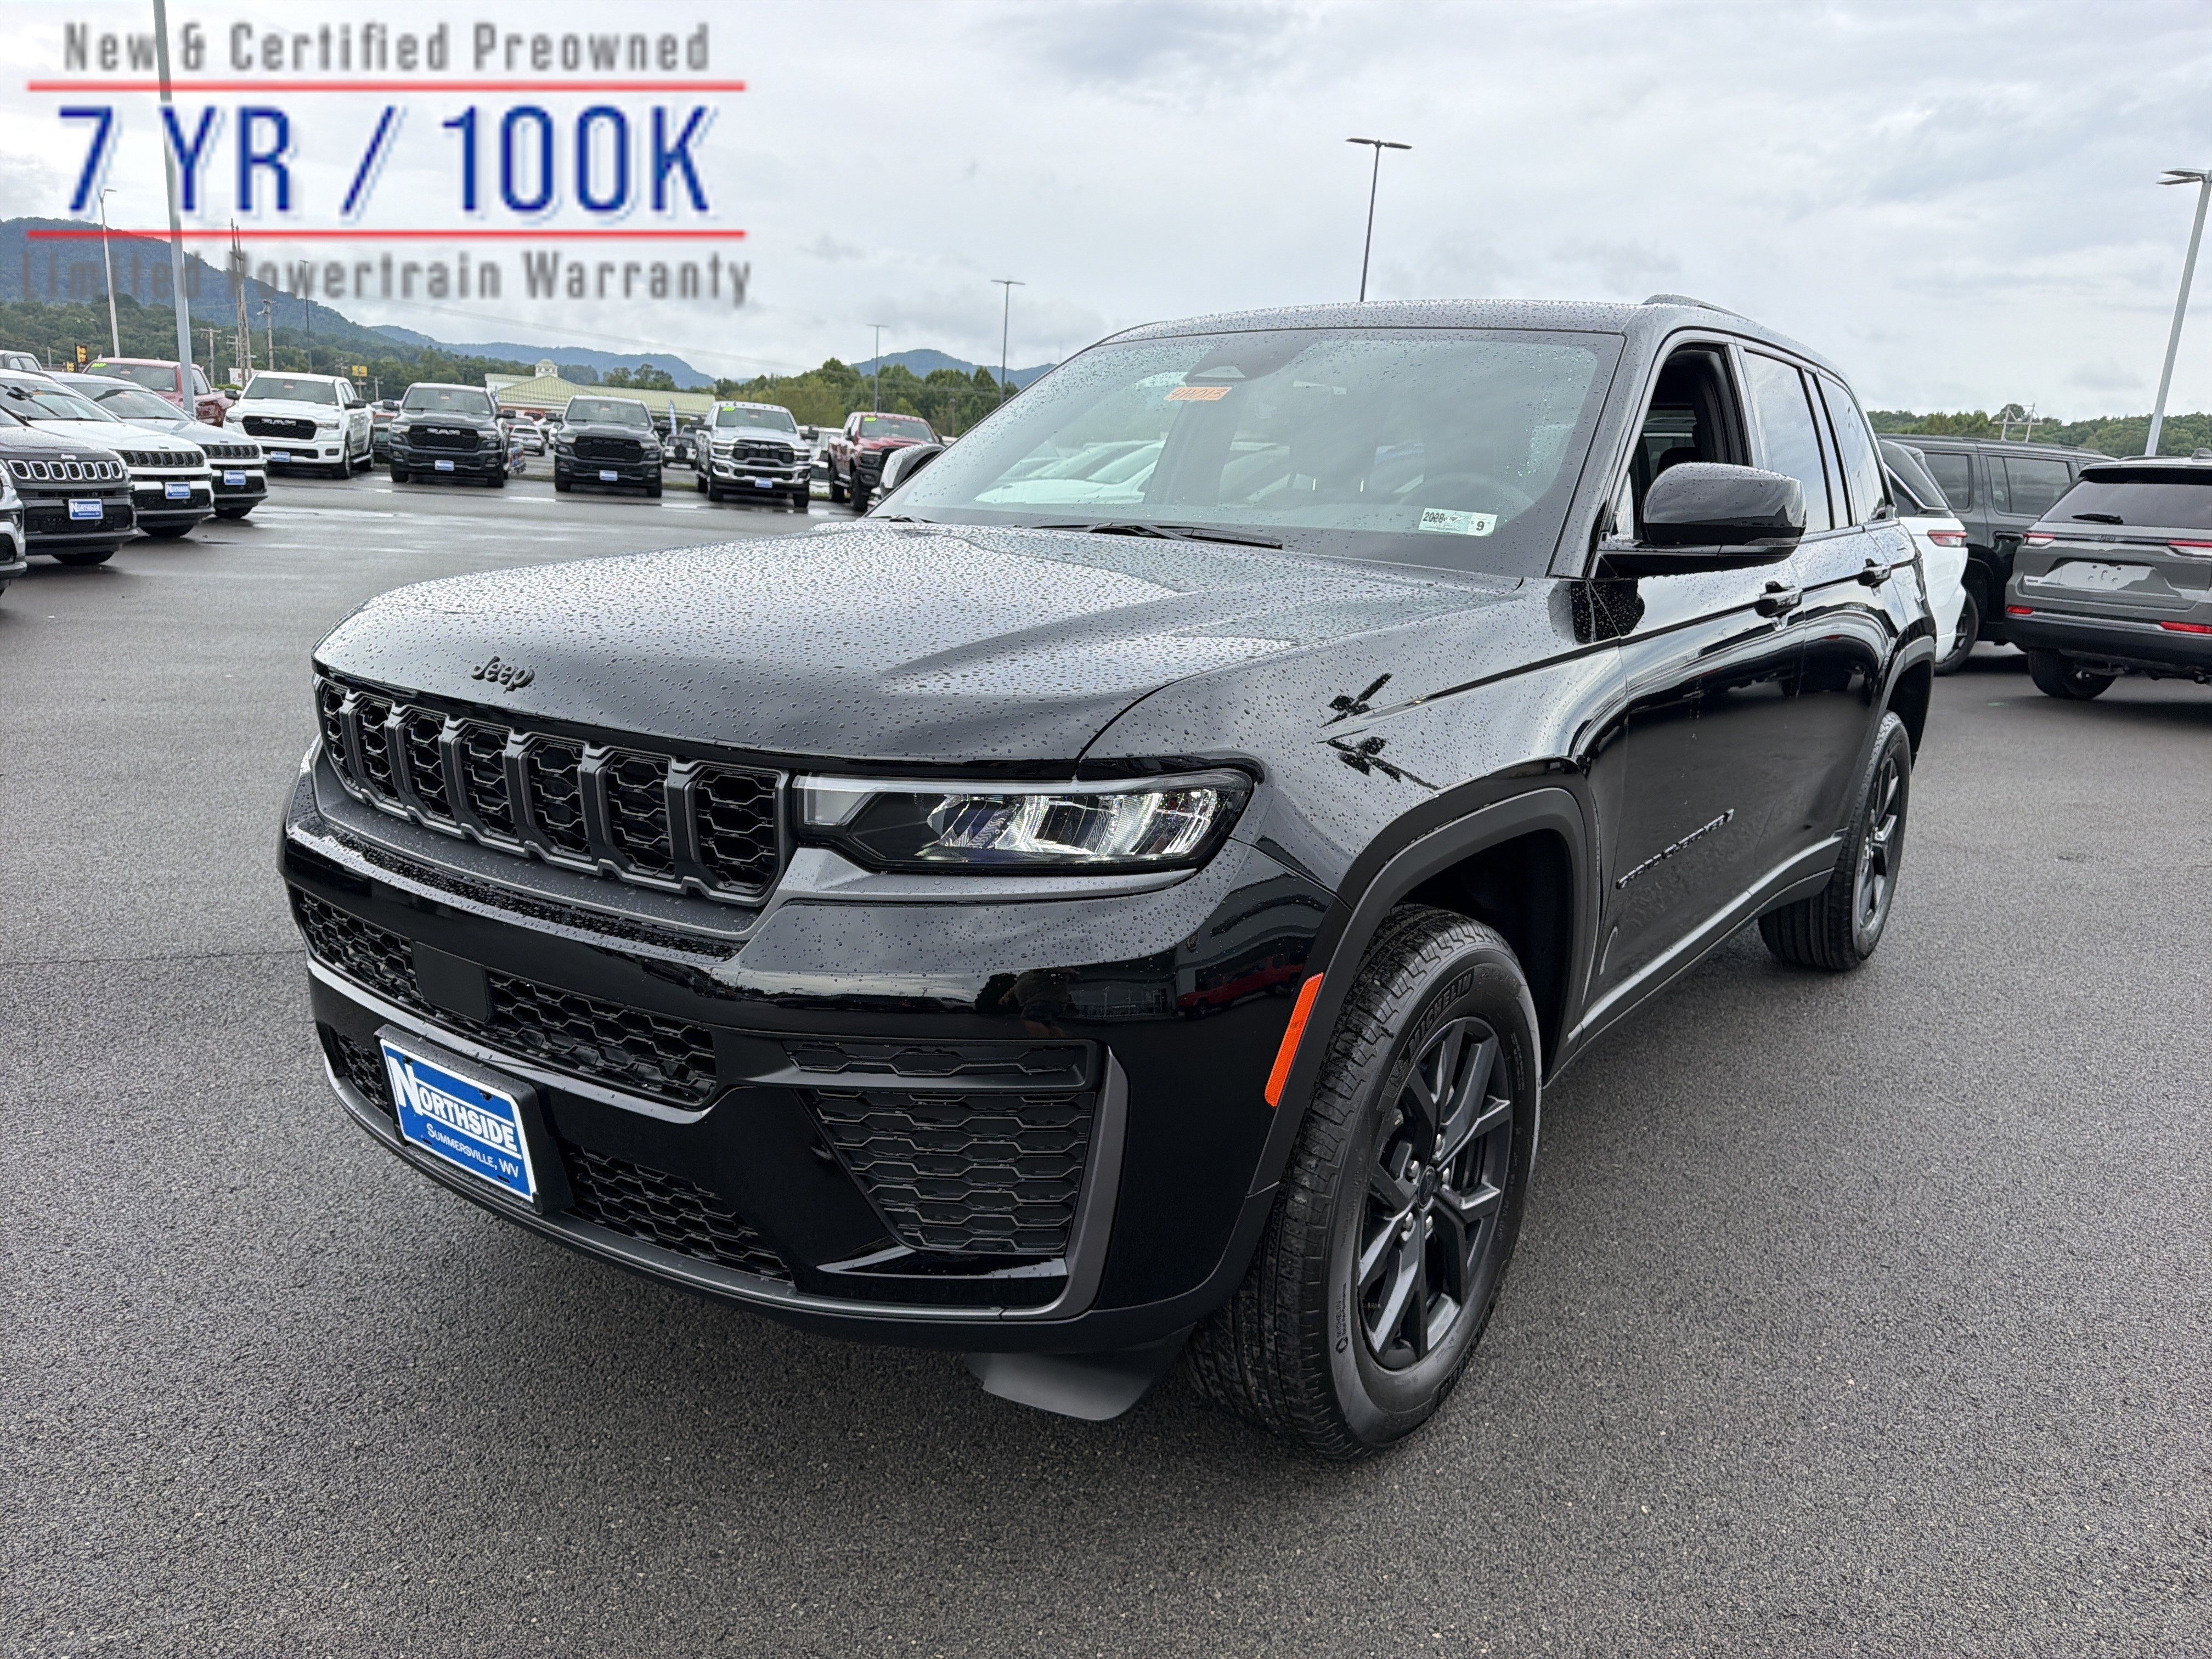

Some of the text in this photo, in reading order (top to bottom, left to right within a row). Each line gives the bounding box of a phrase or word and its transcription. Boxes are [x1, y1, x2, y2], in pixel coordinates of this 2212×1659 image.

[1476, 521, 1485, 531] 9
[471, 656, 535, 692] Jeep
[1408, 972, 1472, 1057] MICHELIN
[387, 1054, 518, 1152] NORTHSIDE
[426, 1123, 518, 1178] SUMMERSVILLE, WV
